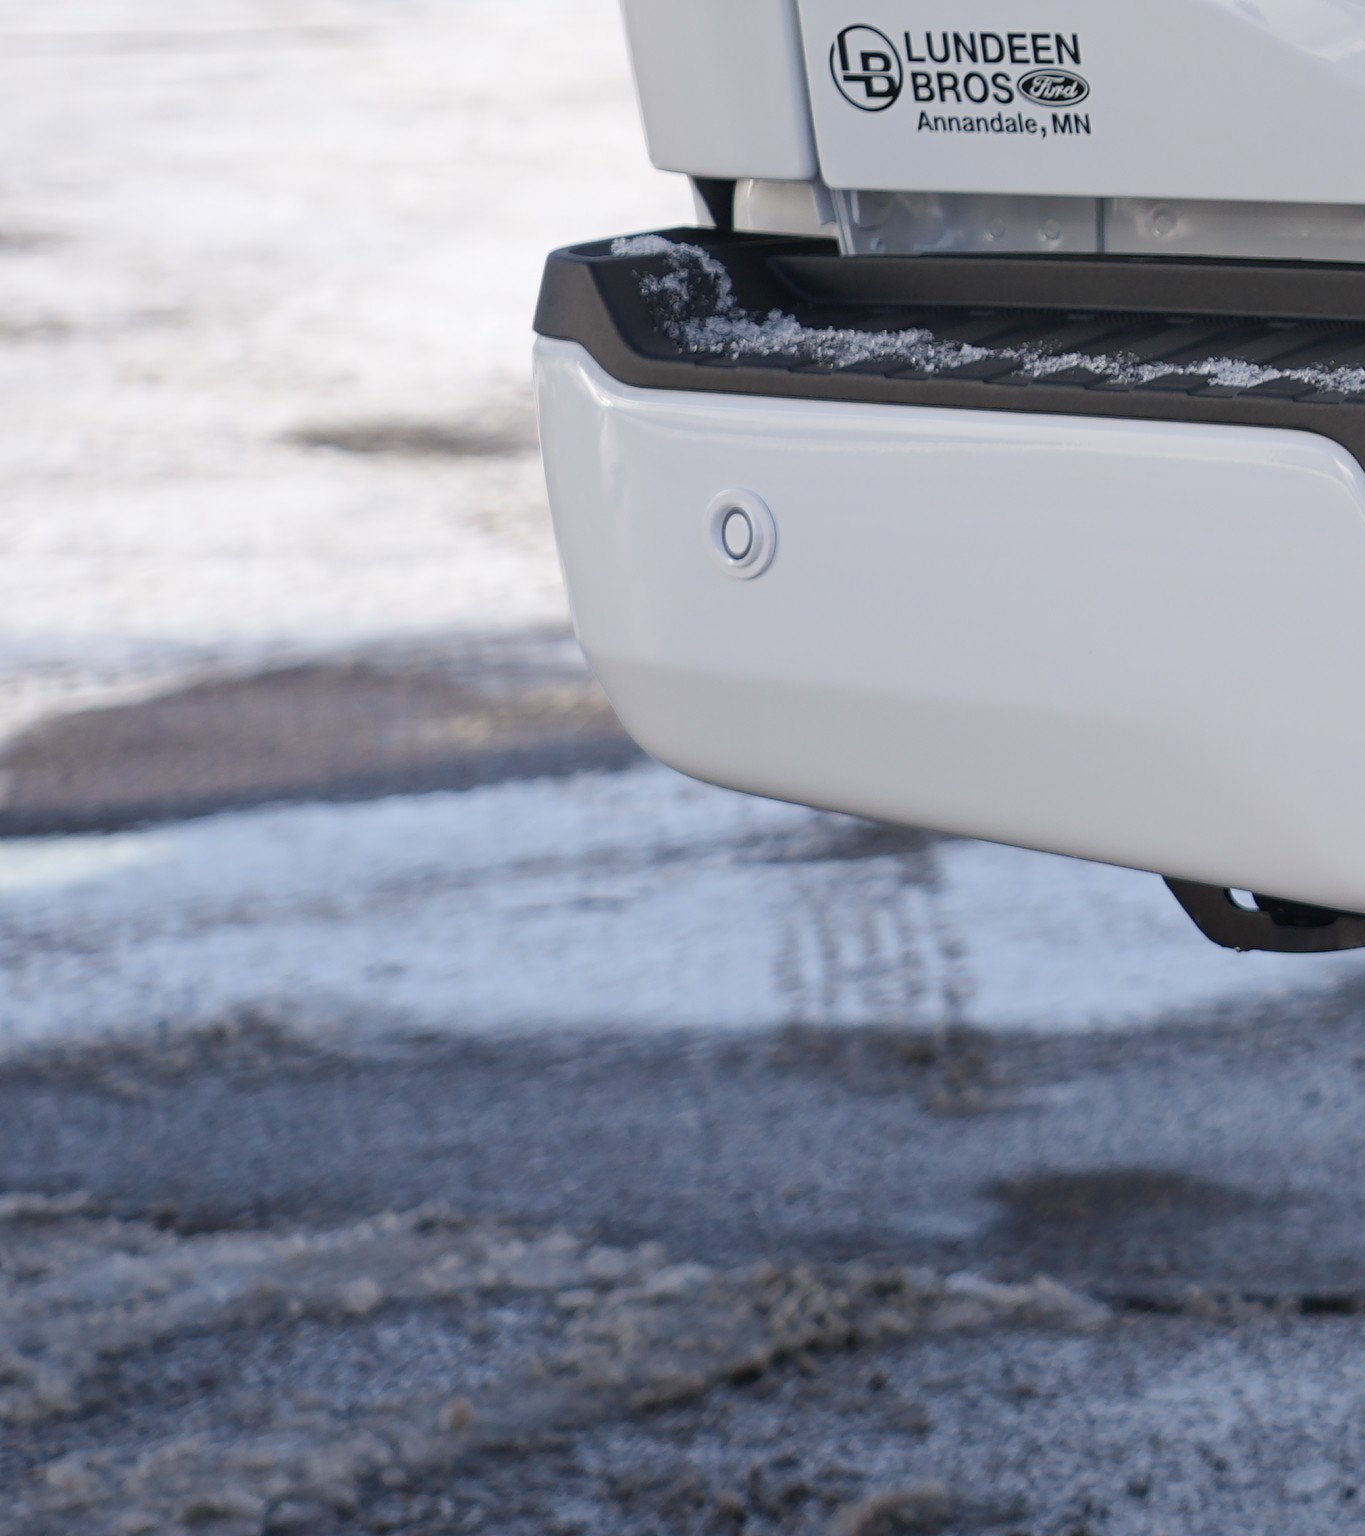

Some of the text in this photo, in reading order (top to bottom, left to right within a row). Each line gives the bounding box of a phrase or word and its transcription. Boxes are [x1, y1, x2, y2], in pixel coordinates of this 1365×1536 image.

[904, 30, 1082, 66] LUNDEEN
[910, 70, 1080, 104] BROS Ford
[917, 110, 1092, 138] Annandale, MN
